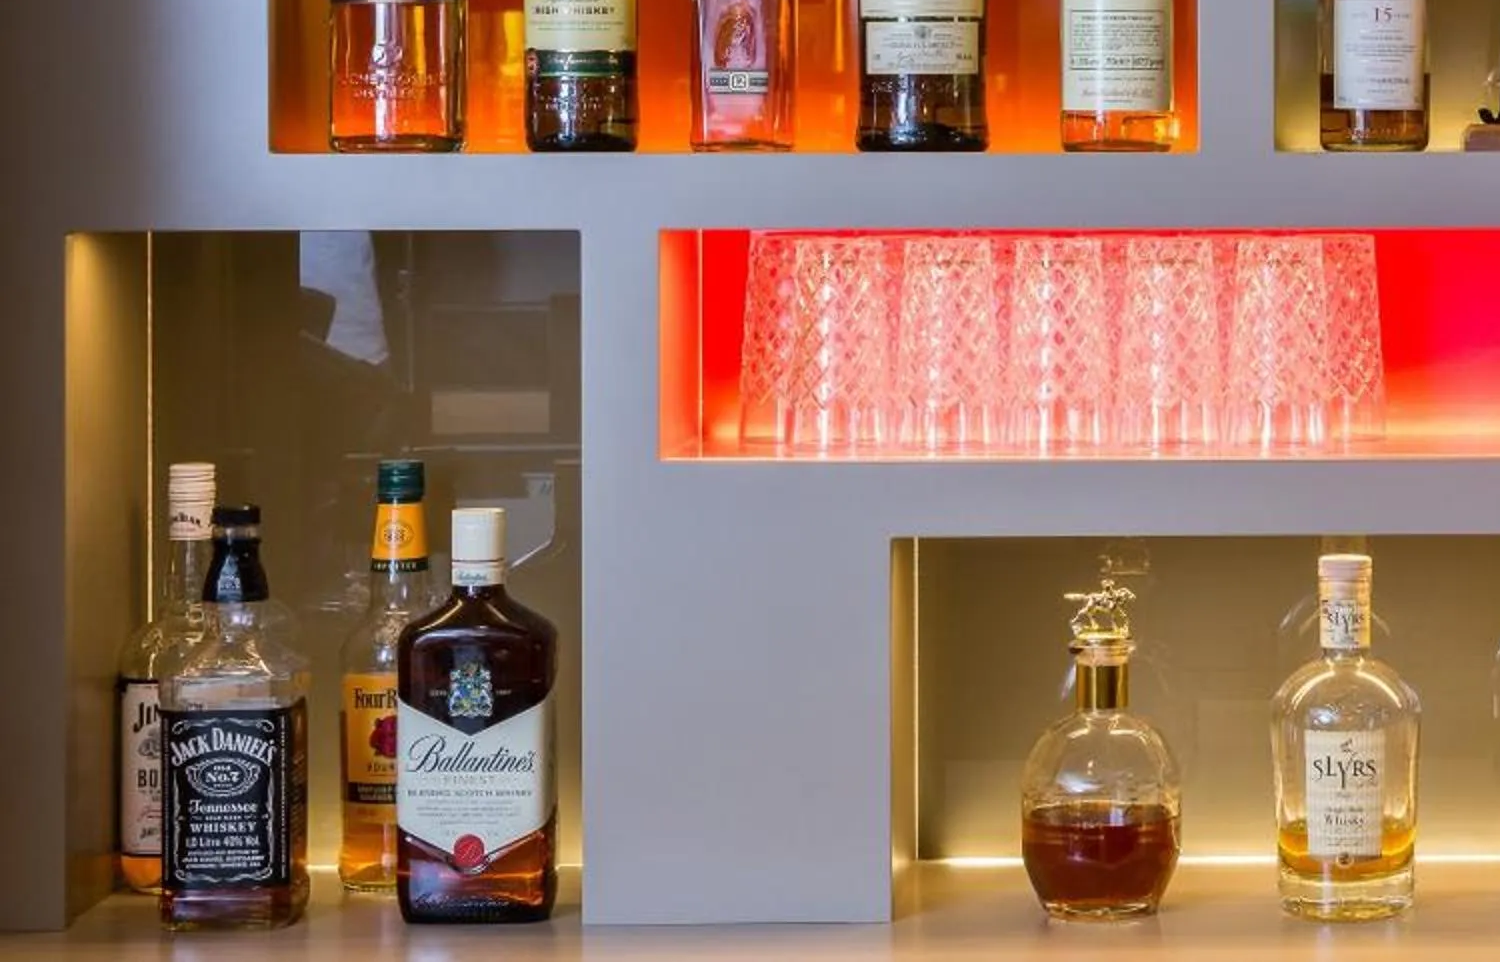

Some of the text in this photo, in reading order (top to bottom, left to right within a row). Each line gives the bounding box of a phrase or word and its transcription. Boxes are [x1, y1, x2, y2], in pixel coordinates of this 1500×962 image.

[1373, 7, 1393, 23] 15
[733, 75, 746, 87] 12
[170, 727, 277, 767] JACK DANIEL'S
[405, 733, 537, 773] Ballantine's
[189, 799, 259, 814] Tennessee
[190, 821, 257, 833] WHISKEY
